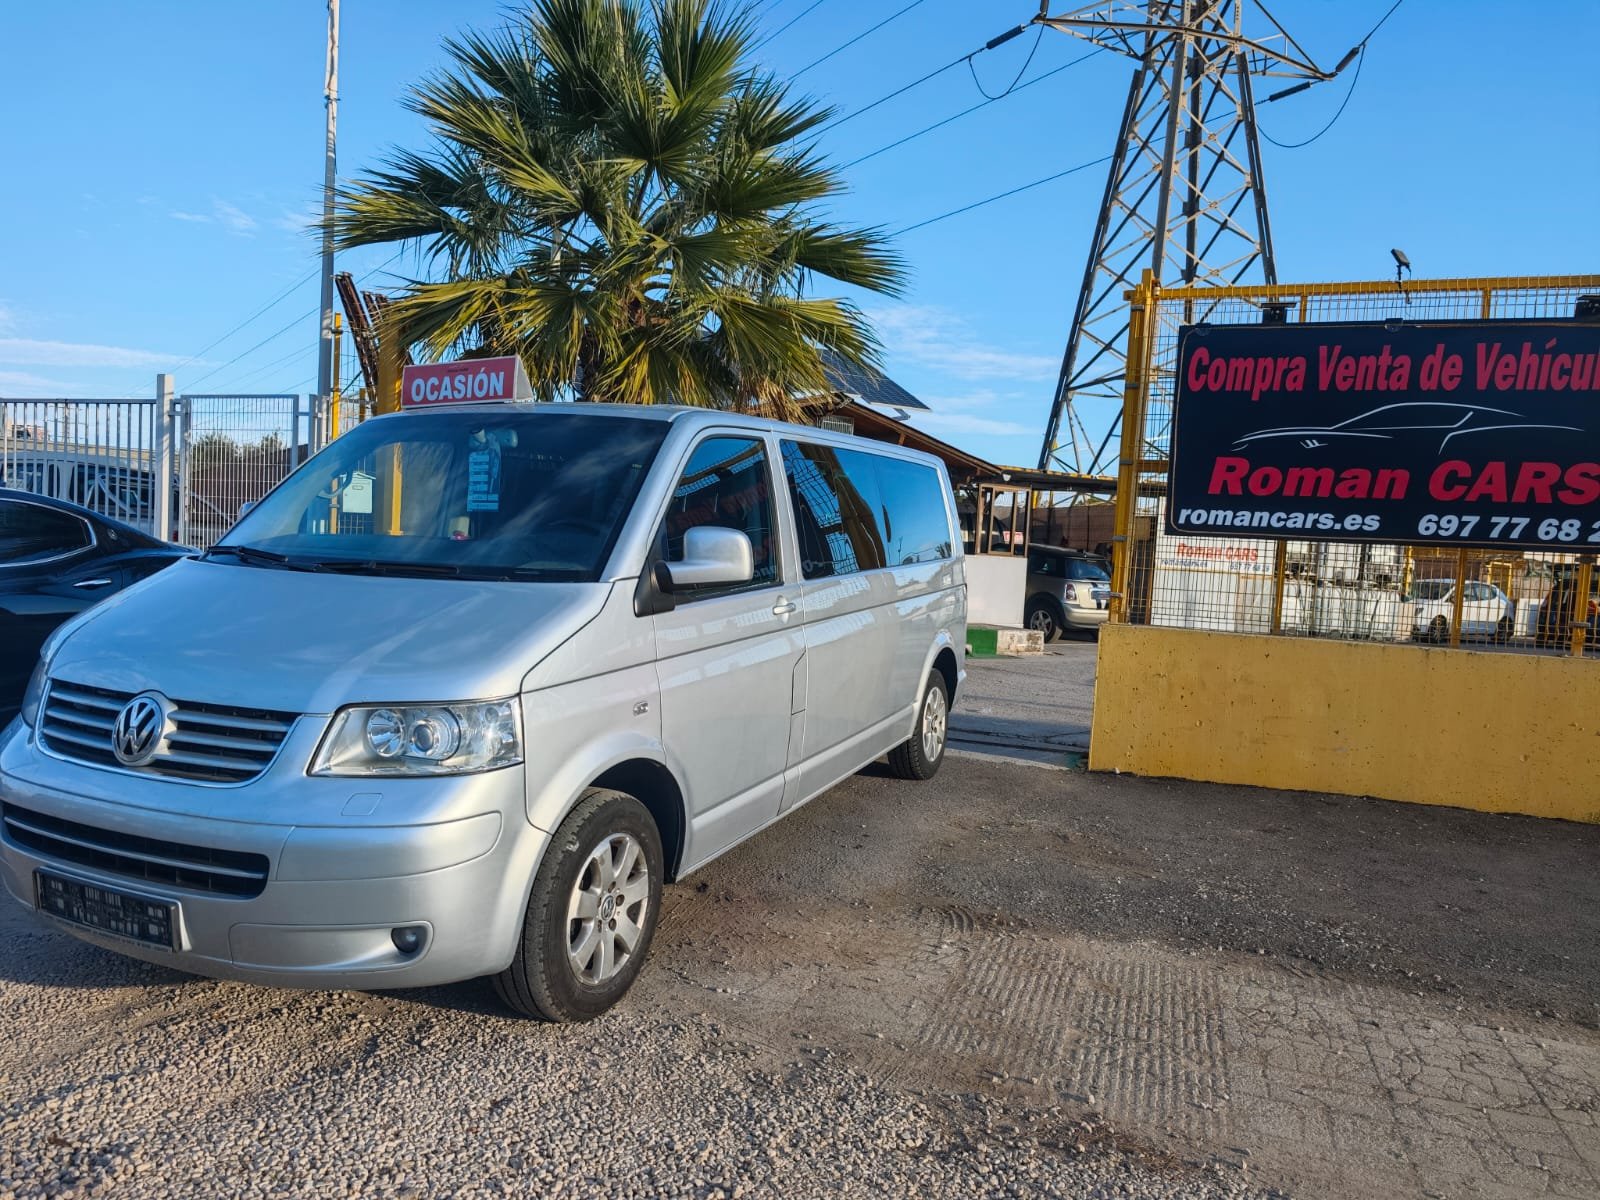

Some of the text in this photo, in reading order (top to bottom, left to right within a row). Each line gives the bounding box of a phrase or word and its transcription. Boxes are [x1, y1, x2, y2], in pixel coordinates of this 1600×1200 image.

[411, 367, 505, 402] OCASIÓN
[1188, 347, 1306, 401] Compra
[1319, 345, 1412, 391] Venta
[1419, 343, 1463, 390] de
[1208, 456, 1600, 505] Roman CARS
[1178, 508, 1381, 531] romancars.es
[1418, 514, 1481, 537] 697
[1489, 516, 1530, 539] 77
[1537, 518, 1582, 542] 68
[1226, 545, 1258, 562] CARS
